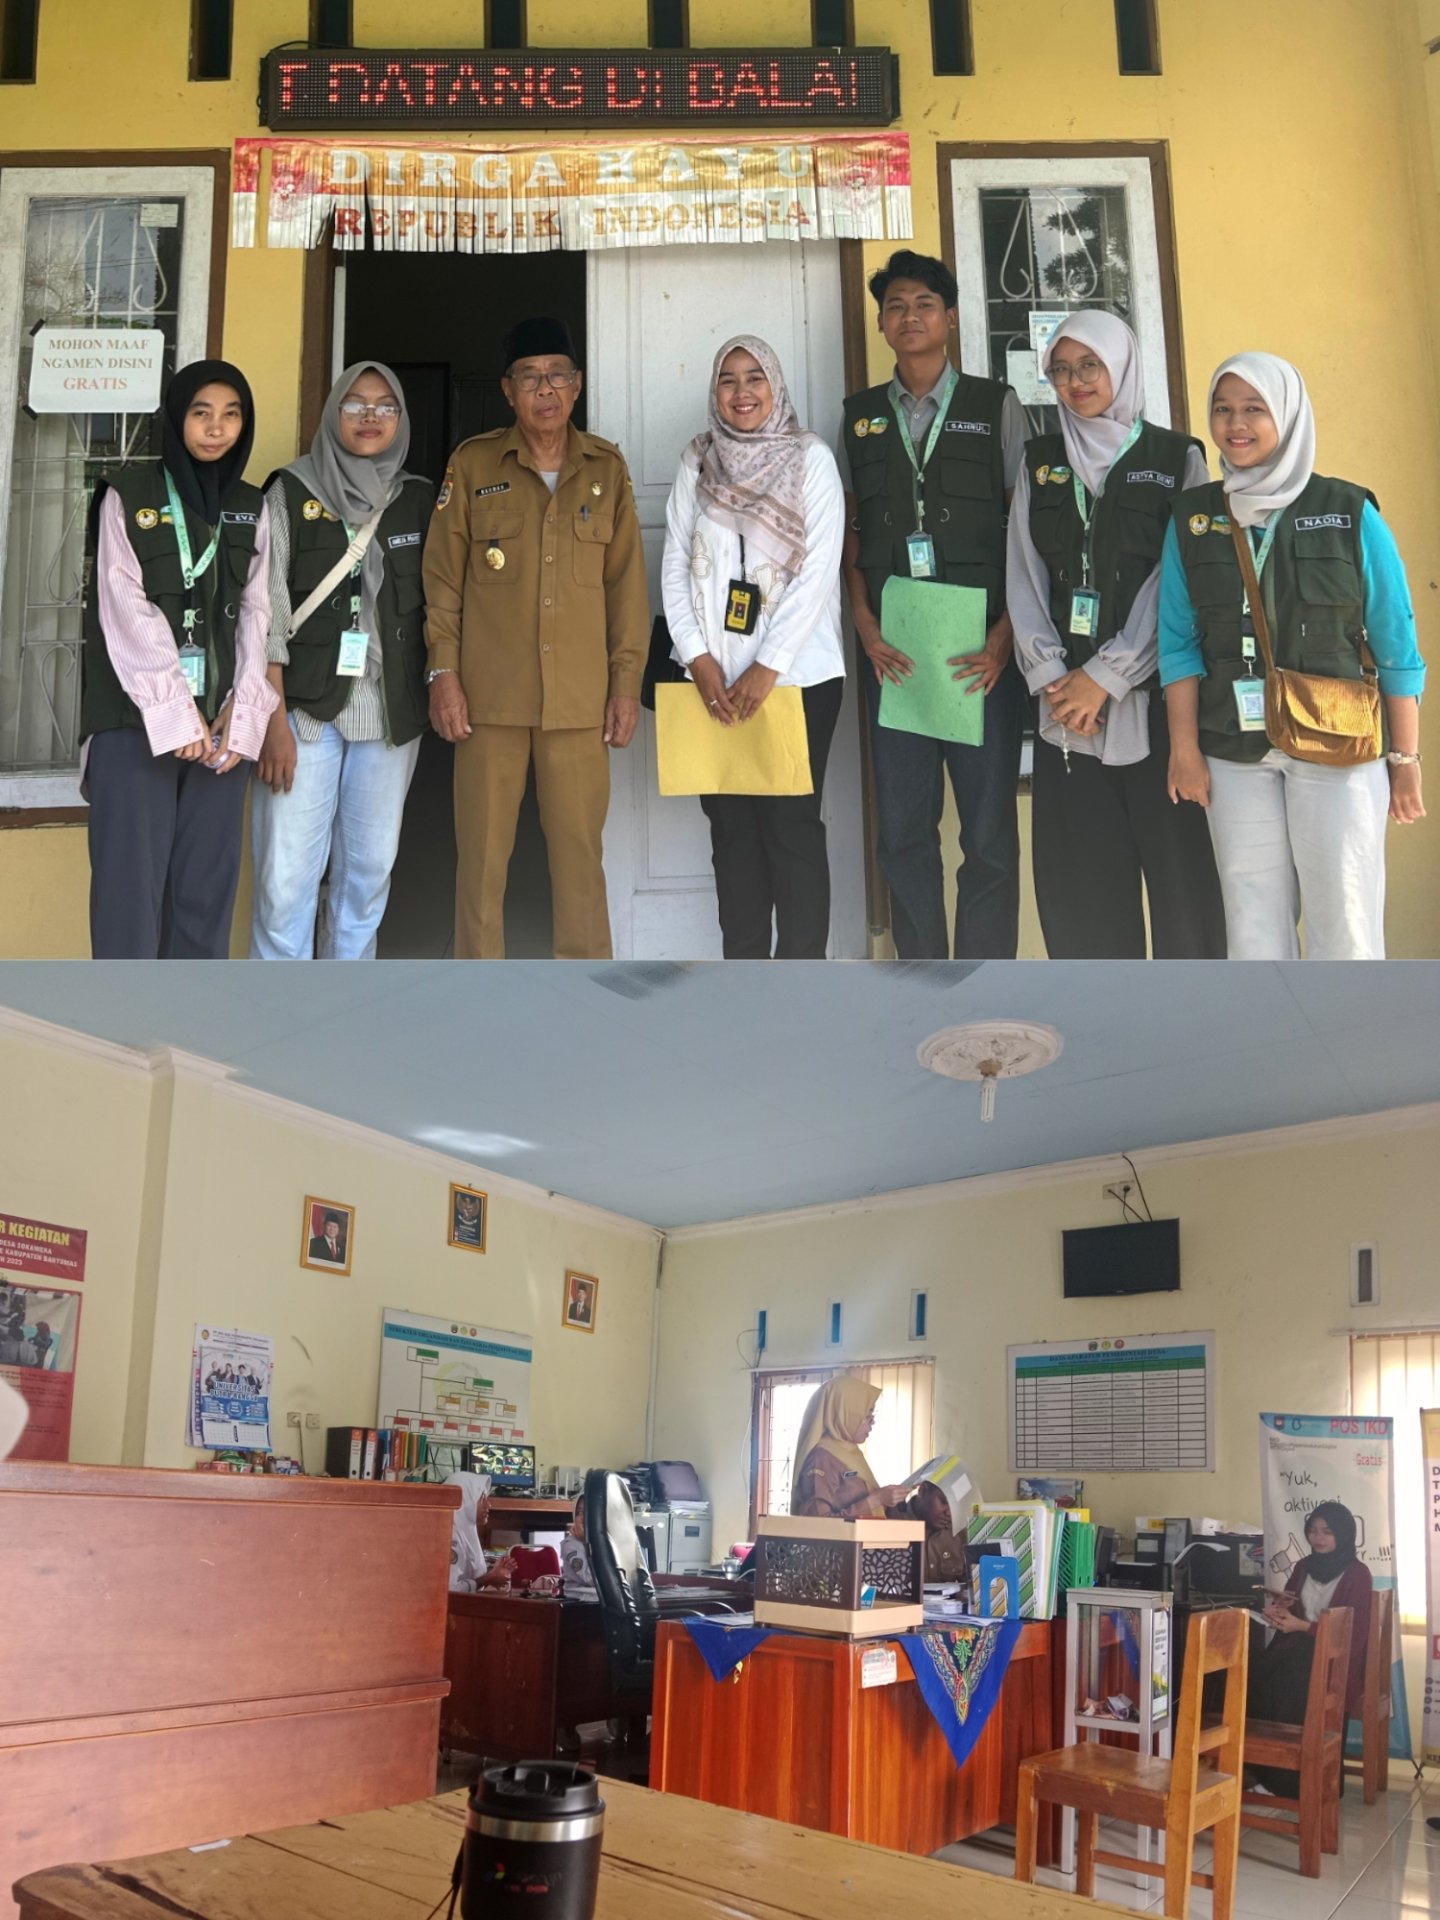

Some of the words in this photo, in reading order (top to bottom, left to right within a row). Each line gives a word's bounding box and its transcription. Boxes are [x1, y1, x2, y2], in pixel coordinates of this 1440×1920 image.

[328, 64, 582, 108] DATANG
[607, 67, 662, 108] DI
[689, 61, 857, 108] BALAI
[335, 207, 562, 239] REPUBLIK
[592, 200, 811, 236] INDONESIA
[48, 339, 103, 350] MOHON
[106, 339, 150, 350] MAAF
[41, 358, 104, 368] NGAMEN
[107, 358, 153, 369] DISINI
[63, 377, 128, 390] GRATIS
[9, 1222, 70, 1246] KEGIATAN
[5, 1248, 42, 1261] KABUPATEN
[1330, 1418, 1359, 1434] POS
[1364, 1419, 1389, 1435] IKD
